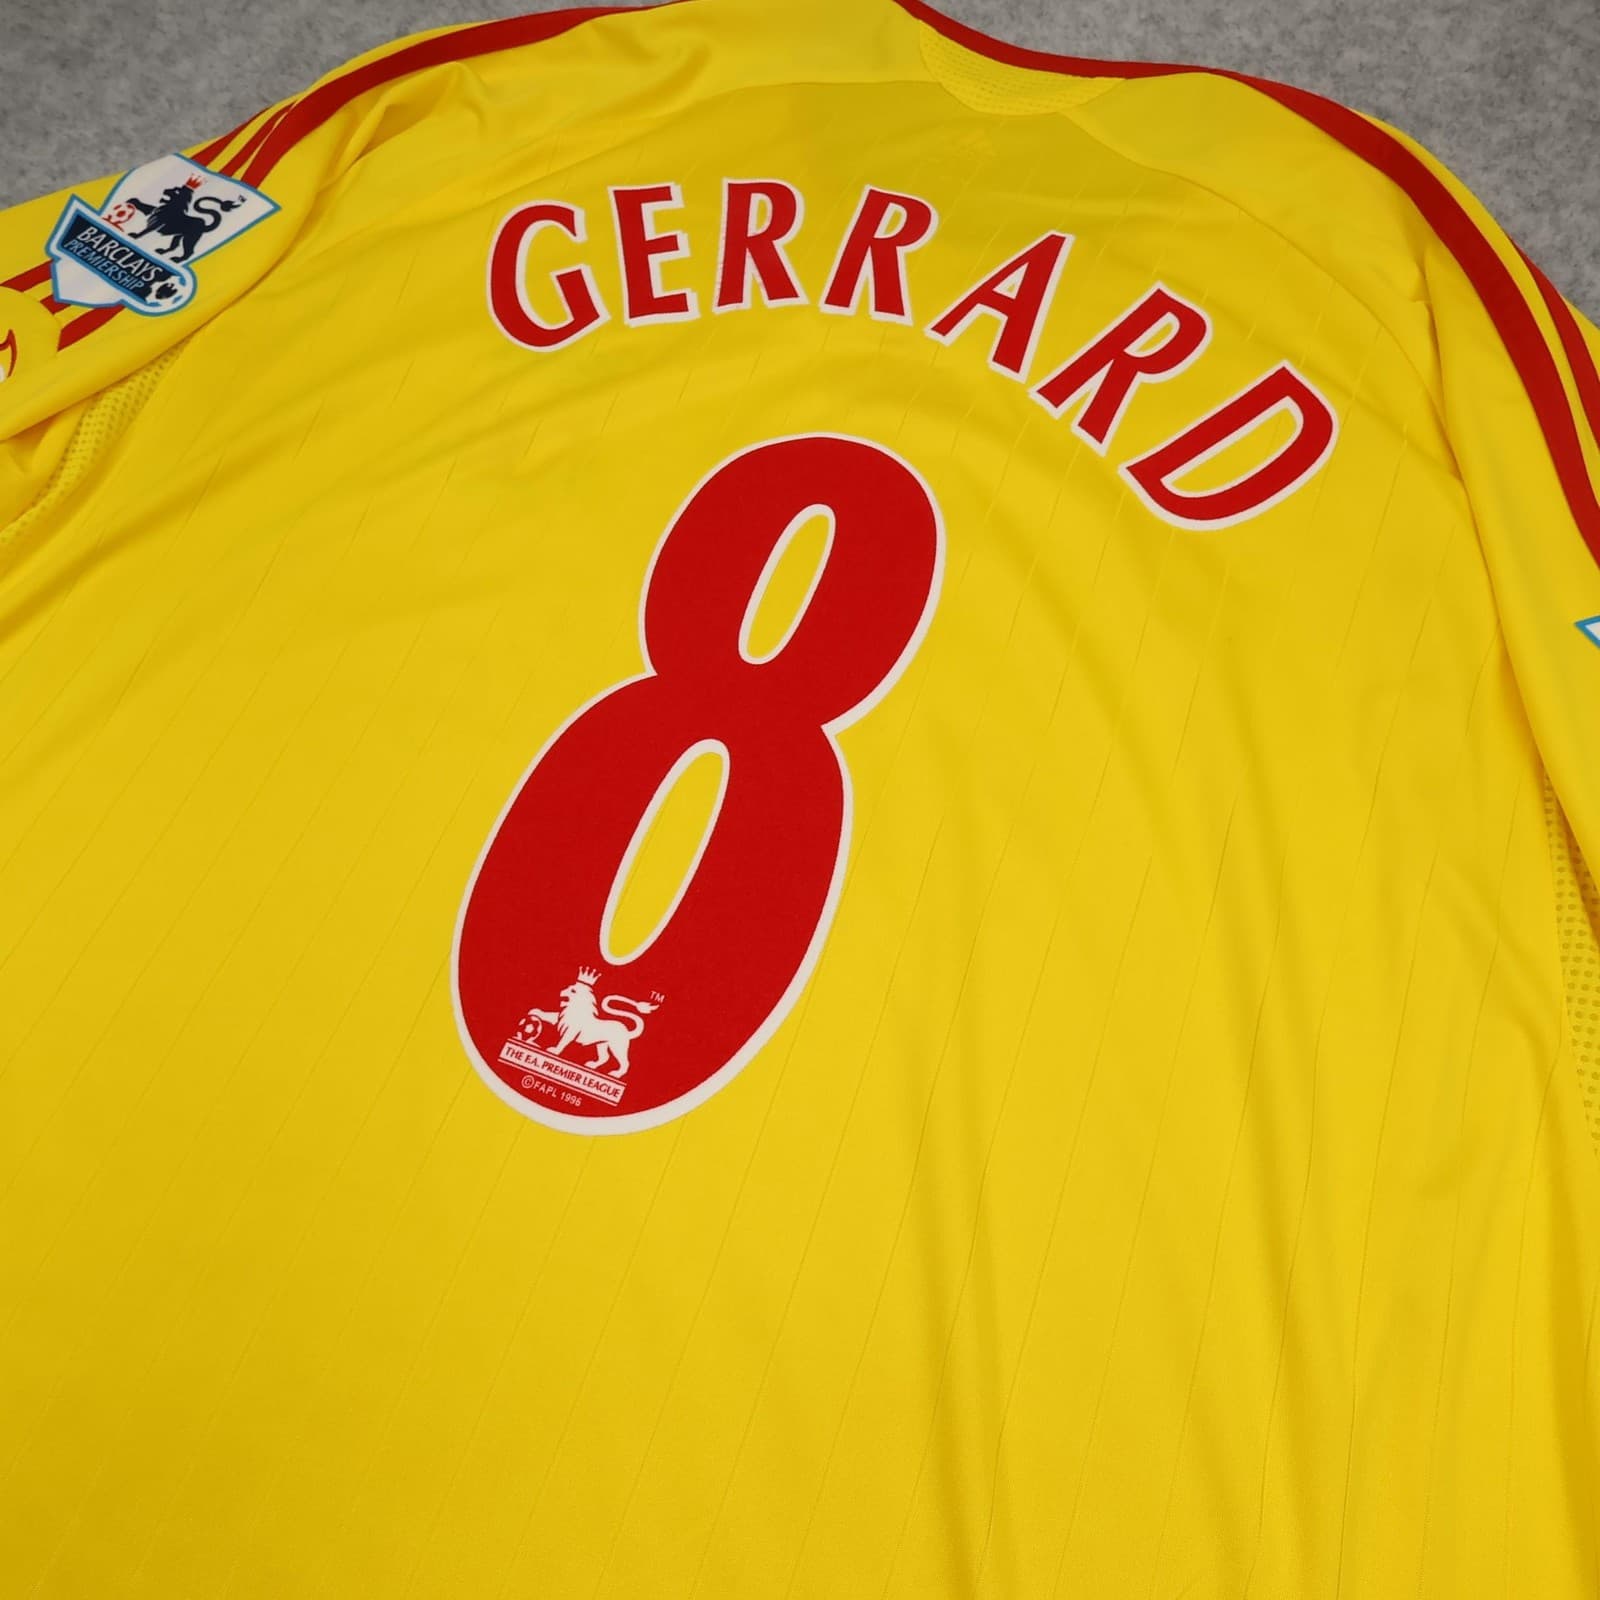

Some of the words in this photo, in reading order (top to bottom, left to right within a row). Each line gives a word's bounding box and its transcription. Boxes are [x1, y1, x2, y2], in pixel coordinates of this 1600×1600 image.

[63, 239, 146, 293] PREMIERSHIP
[76, 226, 164, 283] BARCLAYS
[485, 177, 1340, 531] GERRARD
[450, 432, 947, 1136] 8
[649, 991, 665, 1003] TM
[505, 1046, 523, 1062] THE
[525, 1055, 540, 1068] F.A.
[542, 1062, 582, 1084] PREMIER
[582, 1077, 621, 1098] LEAGUE
